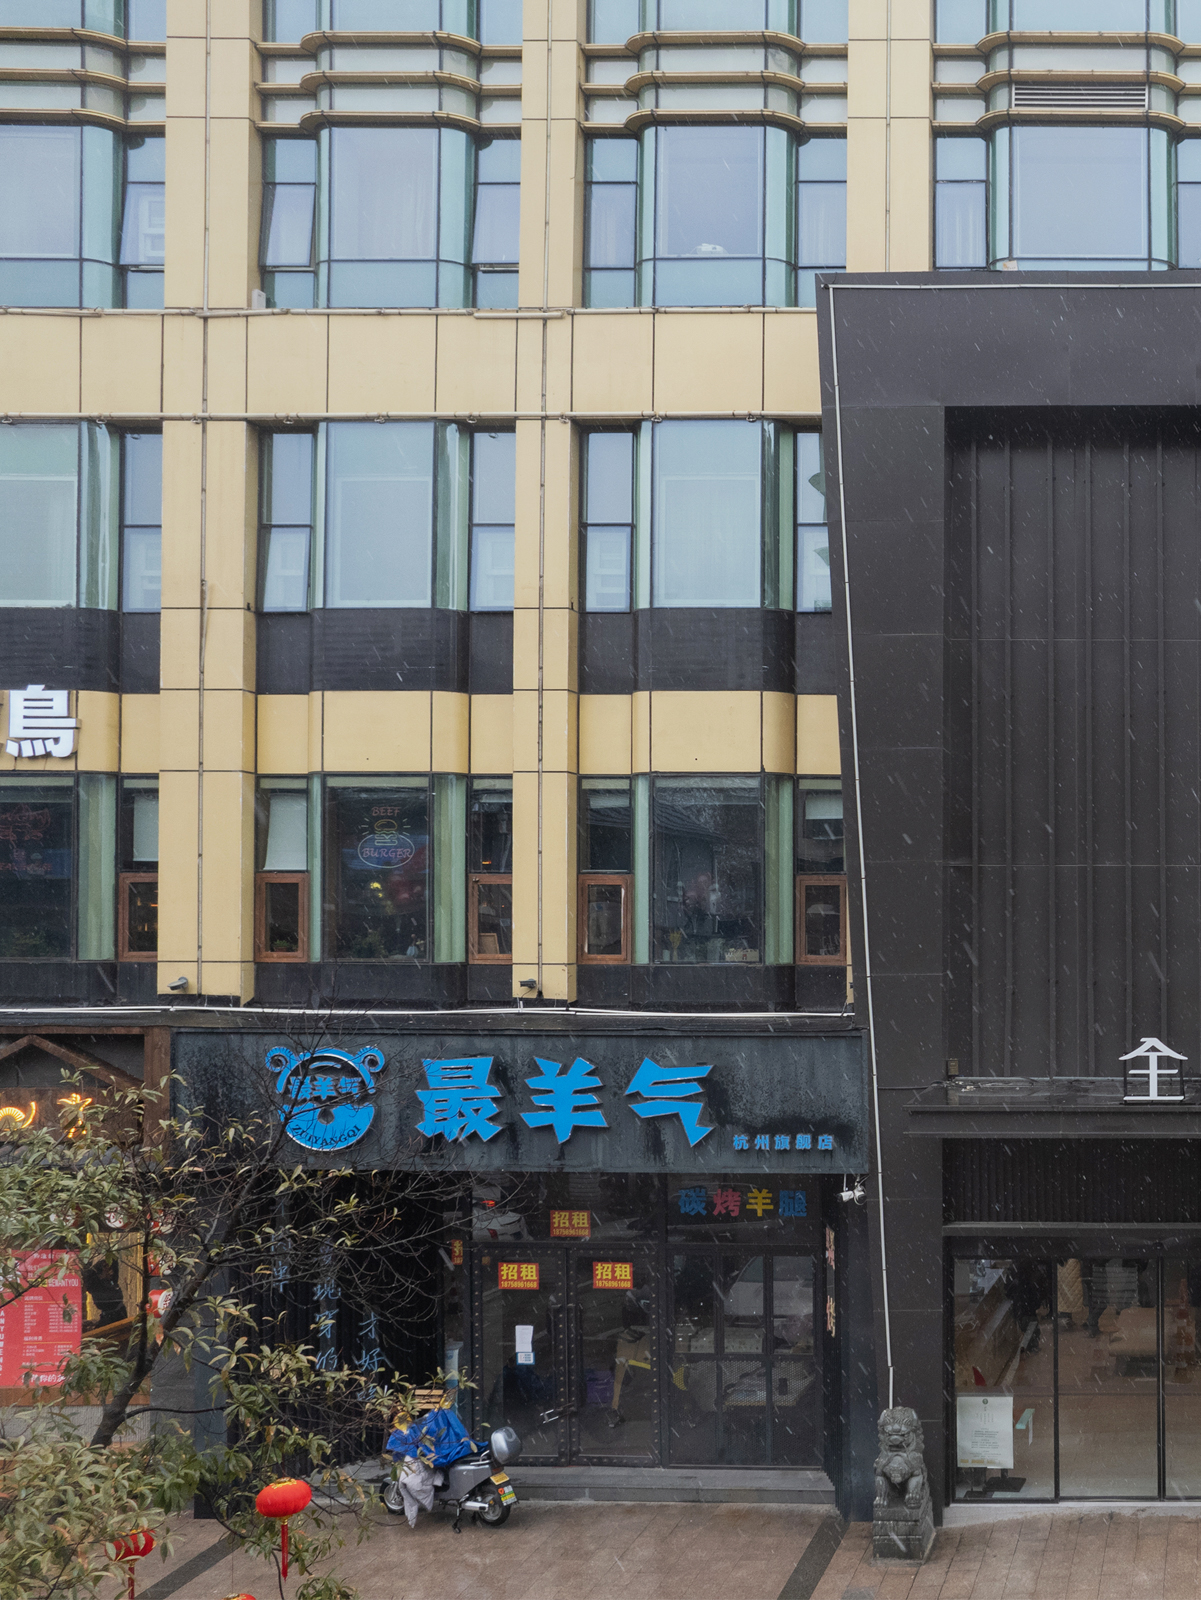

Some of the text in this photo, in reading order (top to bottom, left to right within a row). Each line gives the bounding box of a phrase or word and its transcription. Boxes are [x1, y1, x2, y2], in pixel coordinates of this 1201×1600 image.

[6, 684, 77, 758] 鳥
[371, 806, 401, 817] BEEF
[362, 846, 413, 859] BURGER
[414, 1056, 714, 1148] 最羊气
[733, 1134, 834, 1150] 杭州旗舰店
[678, 1188, 808, 1217] 碳烤羊腿
[552, 1211, 589, 1228] 招租
[500, 1264, 538, 1280] 招租
[595, 1263, 632, 1280] 招租
